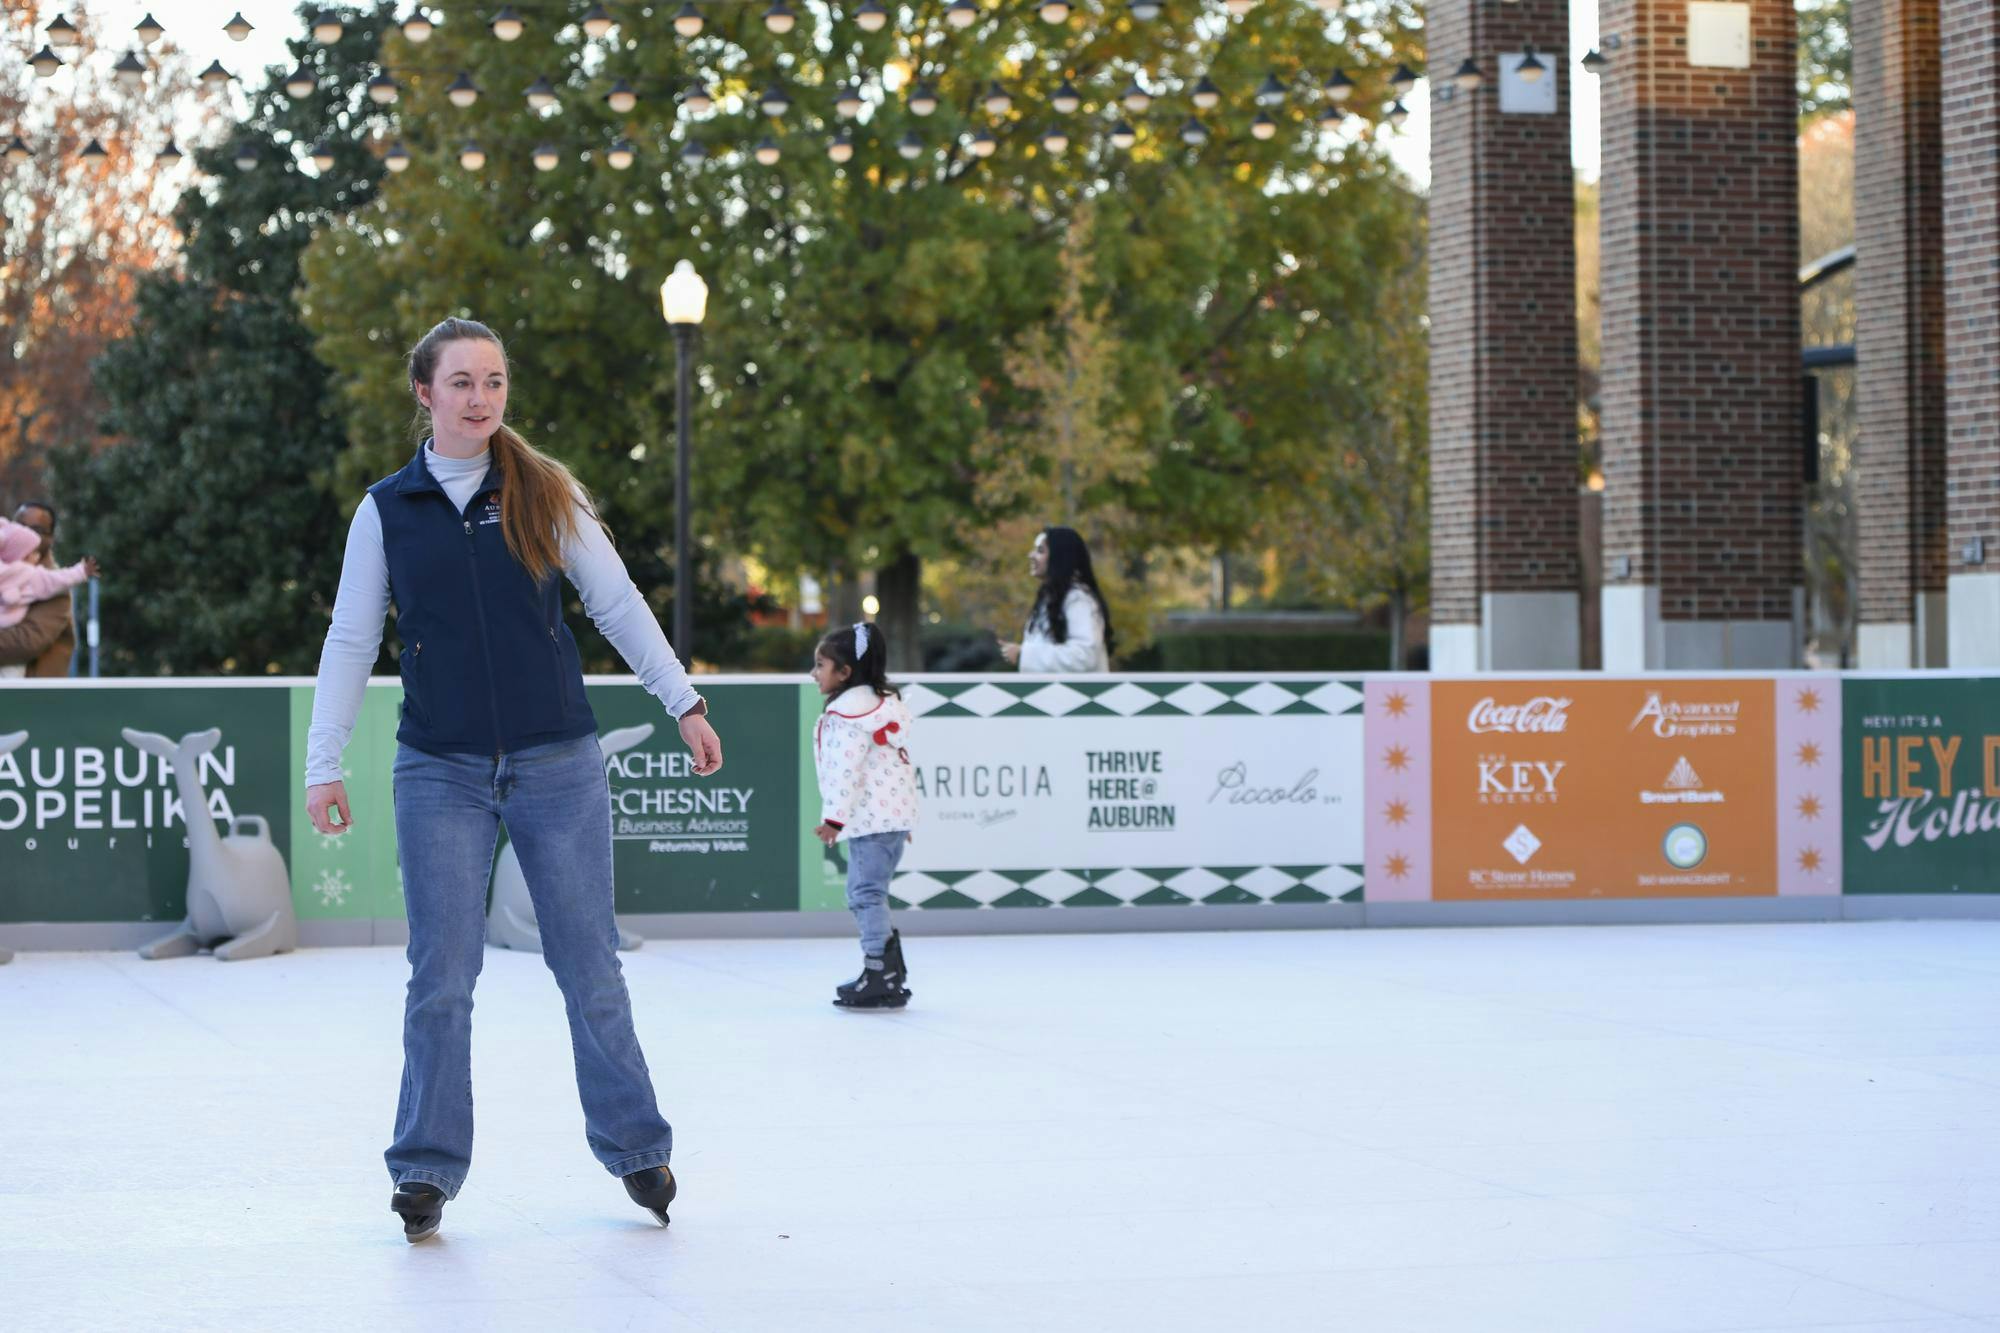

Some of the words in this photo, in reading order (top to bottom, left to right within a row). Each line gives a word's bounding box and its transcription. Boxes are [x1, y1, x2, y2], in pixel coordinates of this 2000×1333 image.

[1467, 696, 1573, 733] Coca-Cola
[1932, 716, 1943, 728] A
[1653, 719, 1737, 739] Graphics
[1477, 761, 1567, 793] KEY
[1862, 735, 1962, 798] HEY
[914, 765, 1052, 798] ARICCIA
[1207, 760, 1320, 805] Piccolo
[618, 818, 683, 834] Business
[687, 817, 749, 833] Advisors
[1087, 805, 1176, 828] AUBURN
[649, 841, 710, 854] Returning
